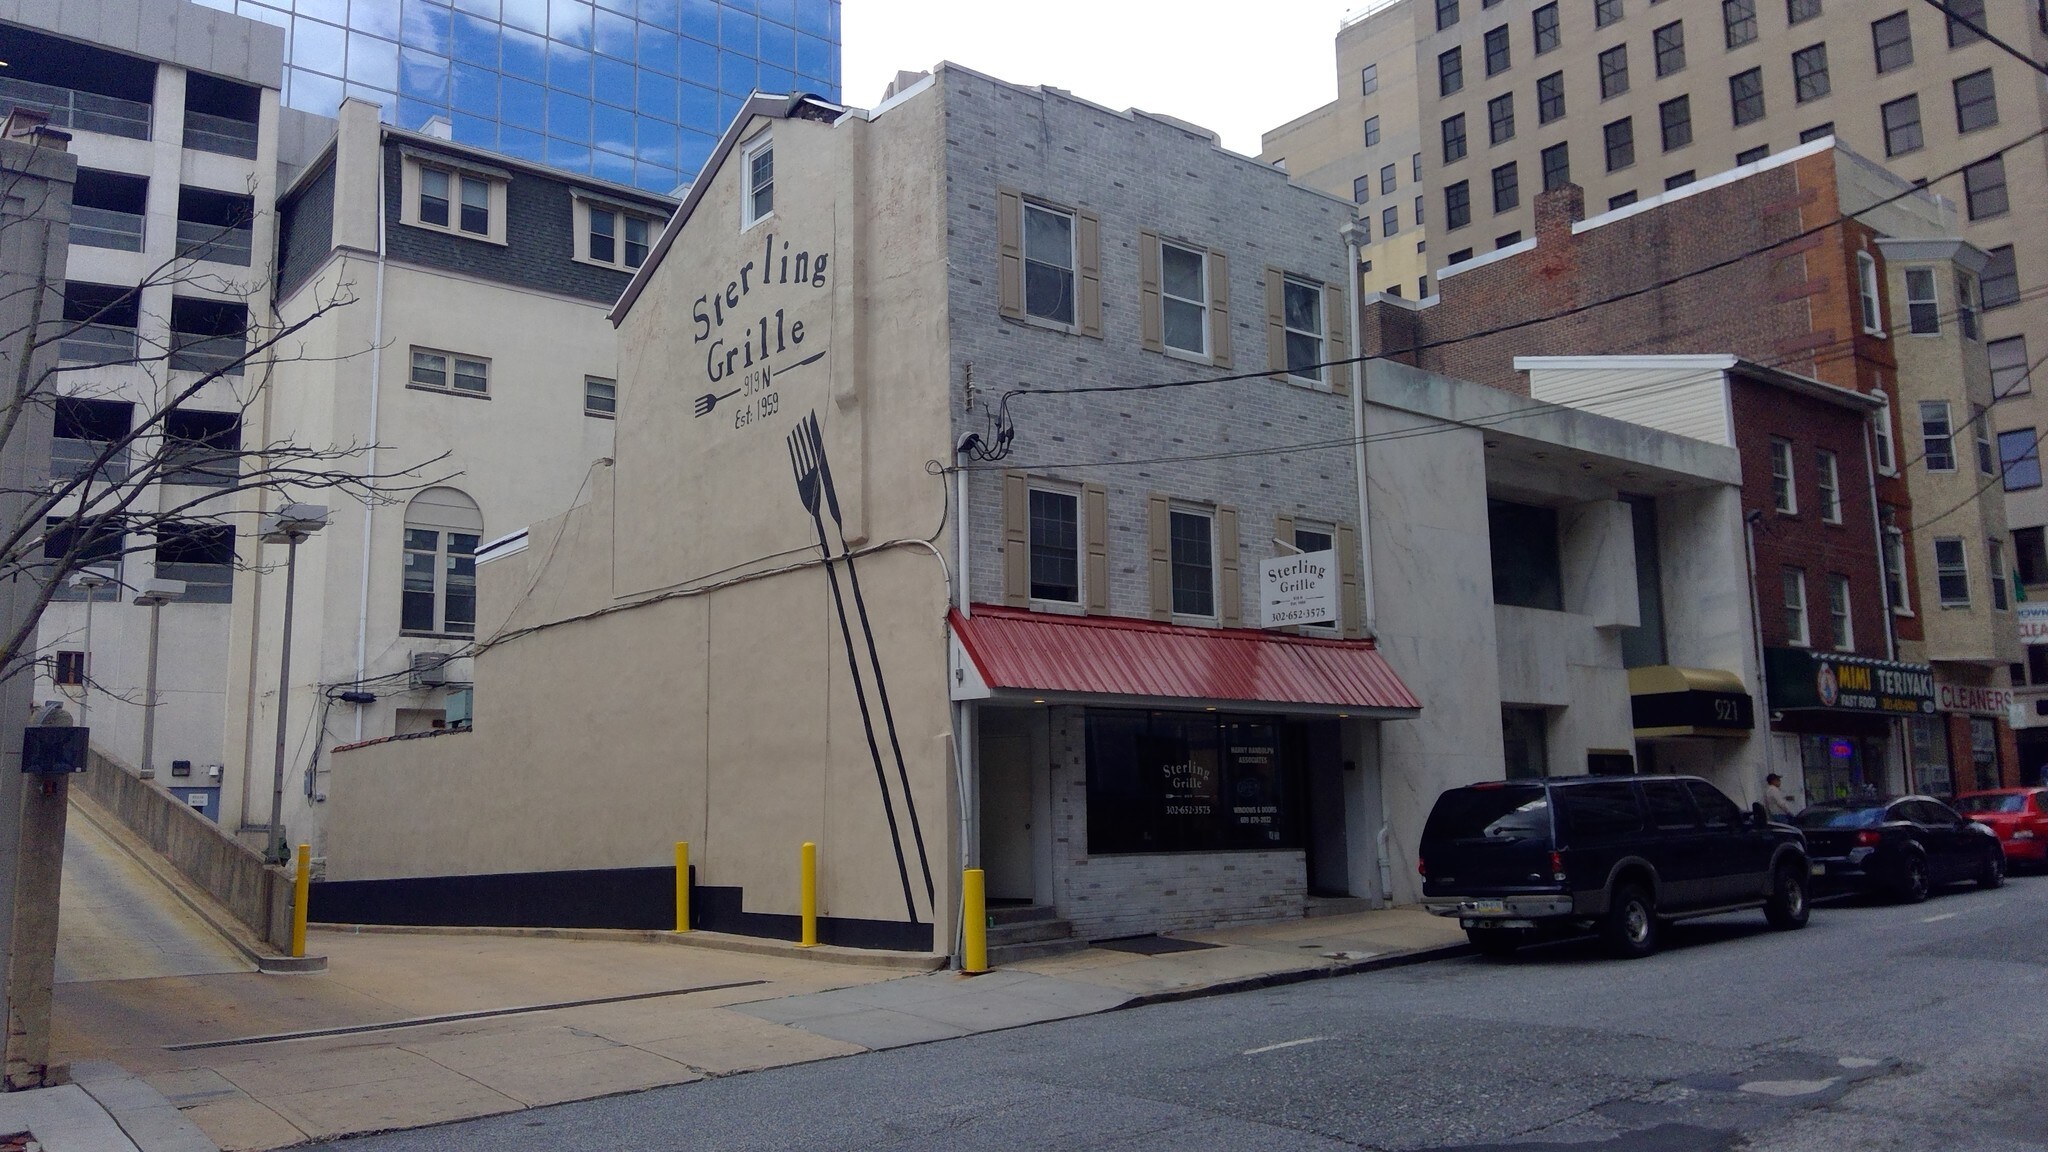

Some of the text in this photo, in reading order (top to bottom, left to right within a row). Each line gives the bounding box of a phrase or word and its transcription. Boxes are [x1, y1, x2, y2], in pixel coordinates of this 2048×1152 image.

[692, 233, 829, 345] Sterling
[707, 308, 805, 383] Grille
[743, 365, 771, 398] 919 N
[757, 392, 780, 421] 1959
[1268, 559, 1326, 583] Sterling
[1280, 578, 1316, 593] Grille
[1838, 664, 1871, 691] MIMI
[1877, 668, 1935, 697] TERIYAKI
[1714, 698, 1738, 721] 921
[1941, 685, 2012, 713] CLEANERS
[1163, 760, 1210, 780] Sterling
[1172, 777, 1202, 789] Grille
